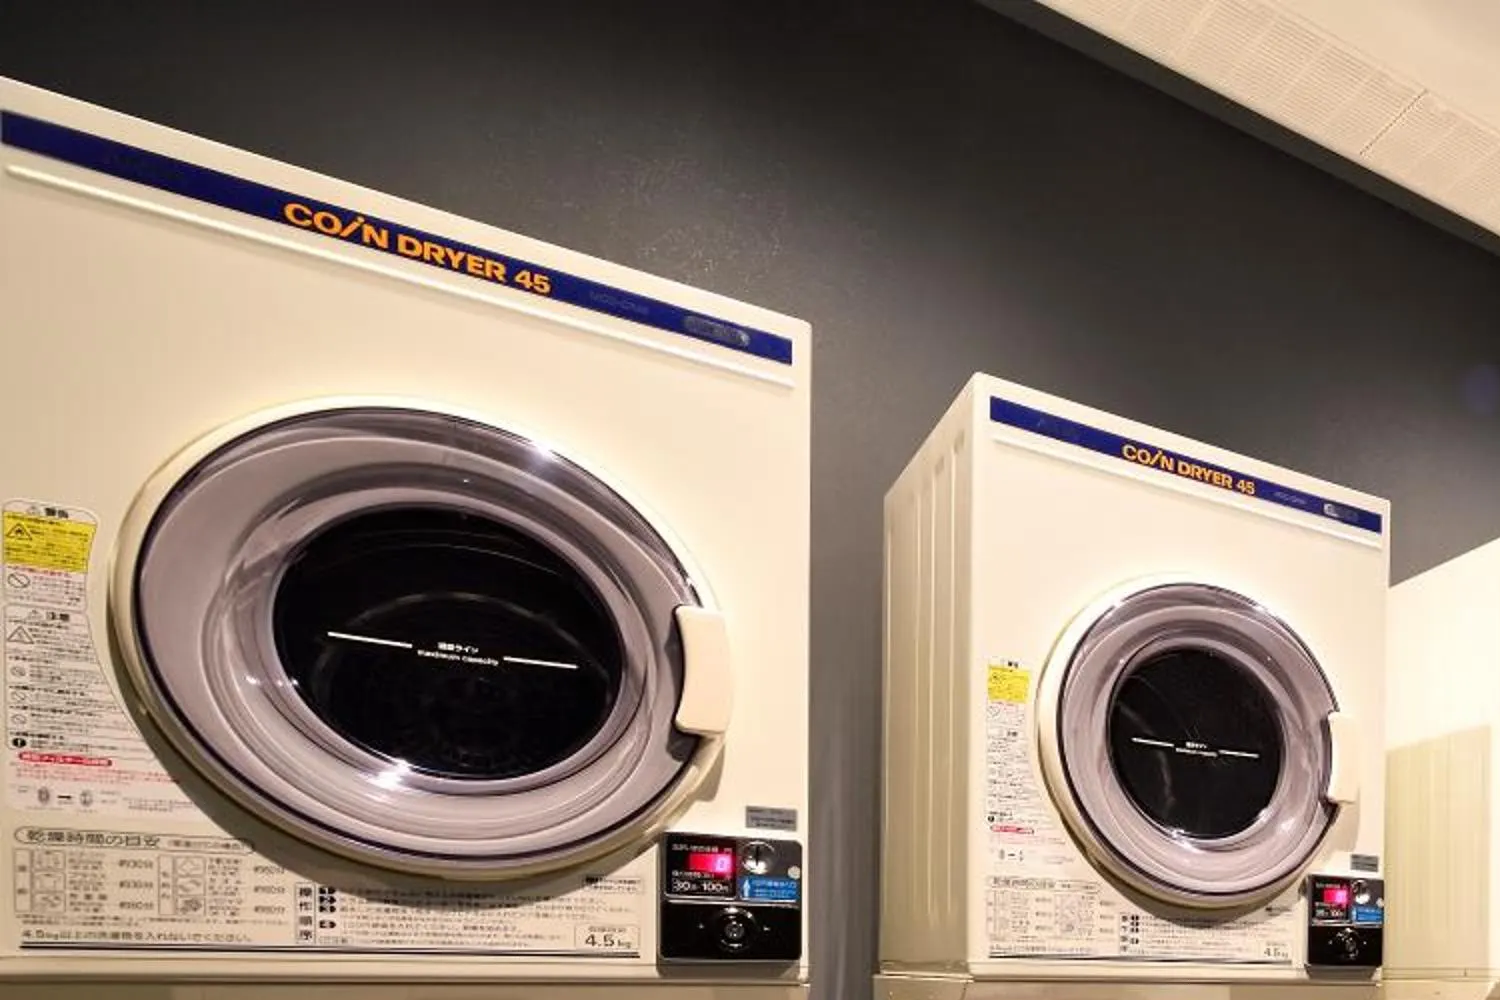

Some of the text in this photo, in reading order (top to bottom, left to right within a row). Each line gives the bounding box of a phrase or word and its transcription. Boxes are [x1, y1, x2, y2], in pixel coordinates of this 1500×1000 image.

[397, 232, 505, 283] DRYER
[514, 270, 551, 294] 45
[1177, 461, 1233, 488] DRYER
[1236, 479, 1256, 495] 45
